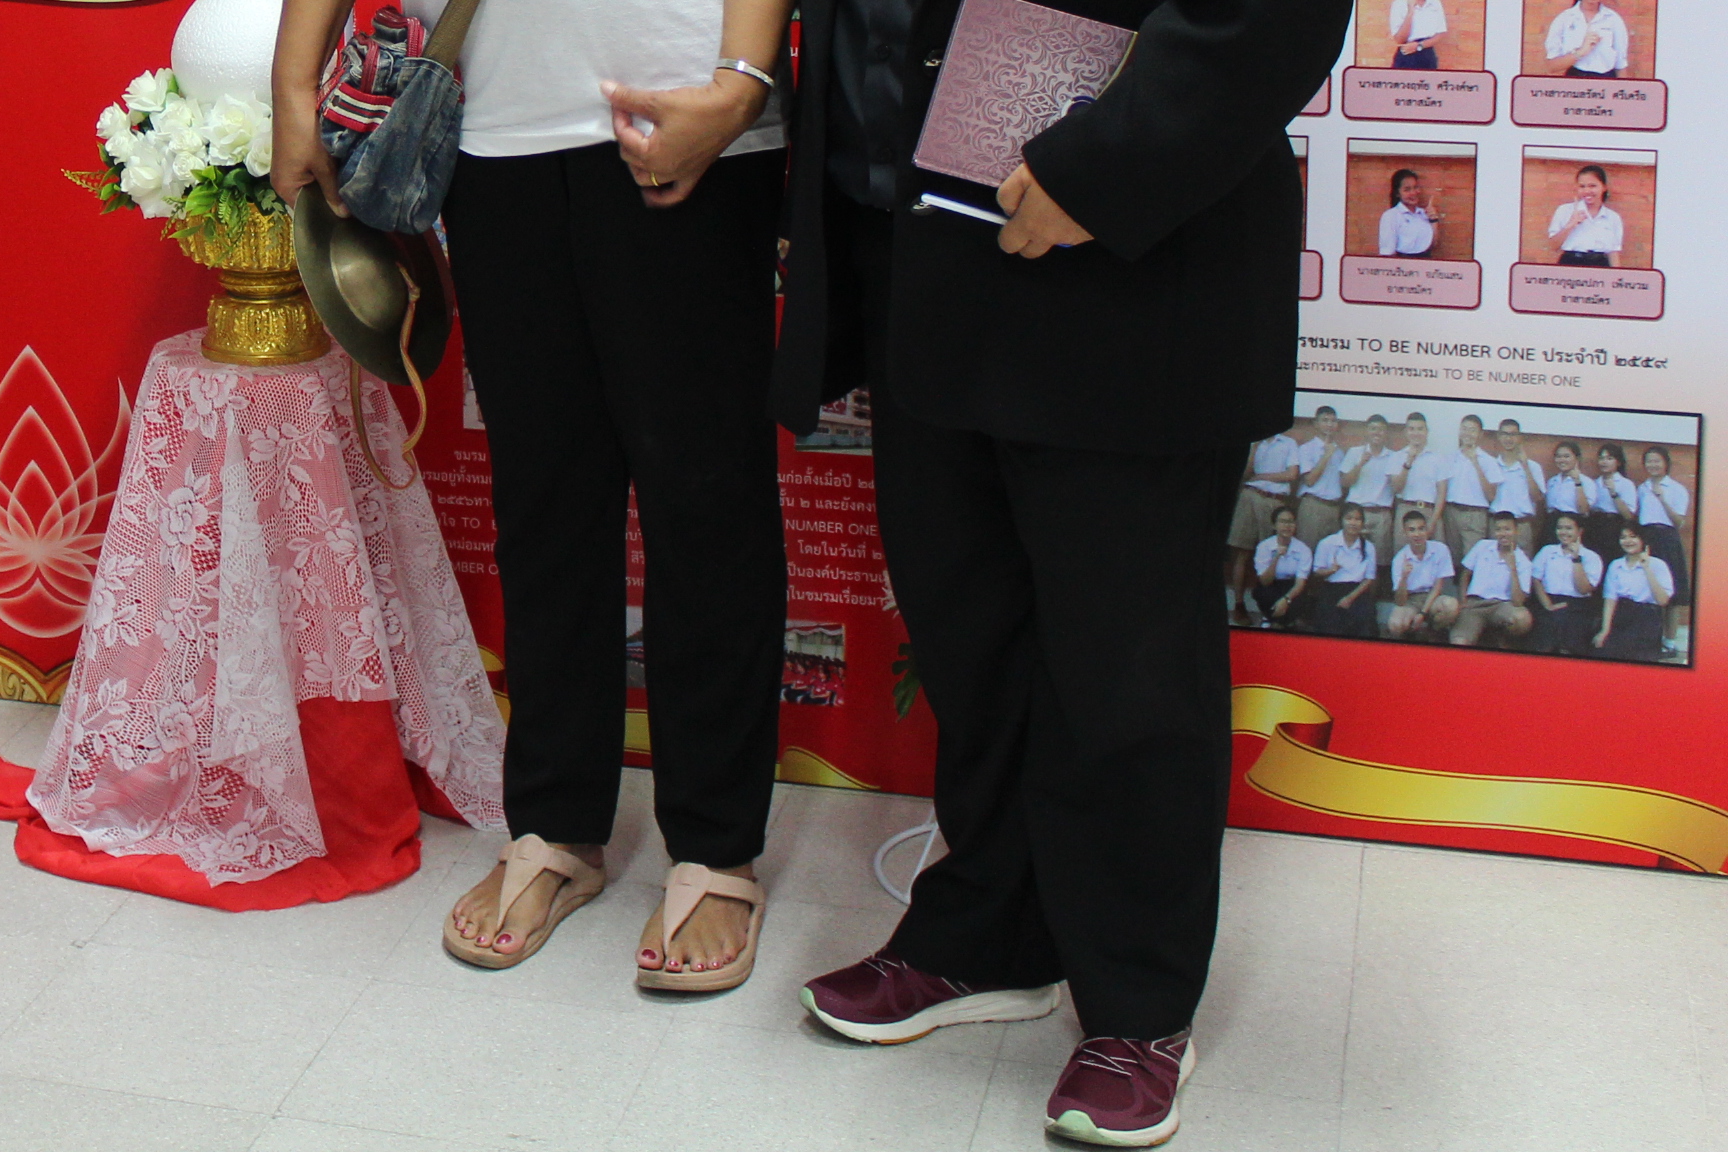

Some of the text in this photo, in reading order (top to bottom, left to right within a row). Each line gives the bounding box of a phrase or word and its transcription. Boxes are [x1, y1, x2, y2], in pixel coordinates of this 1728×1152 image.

[1356, 336, 1383, 353] TO
[1388, 339, 1411, 355] BE
[1415, 341, 1492, 360] NUMBER
[1496, 345, 1536, 362] ONE
[1542, 347, 1609, 367] ประจำปี
[1442, 367, 1582, 388] TO BE NUMBER ONE
[461, 516, 481, 529] TO
[785, 518, 879, 537] NUMBER ONE
